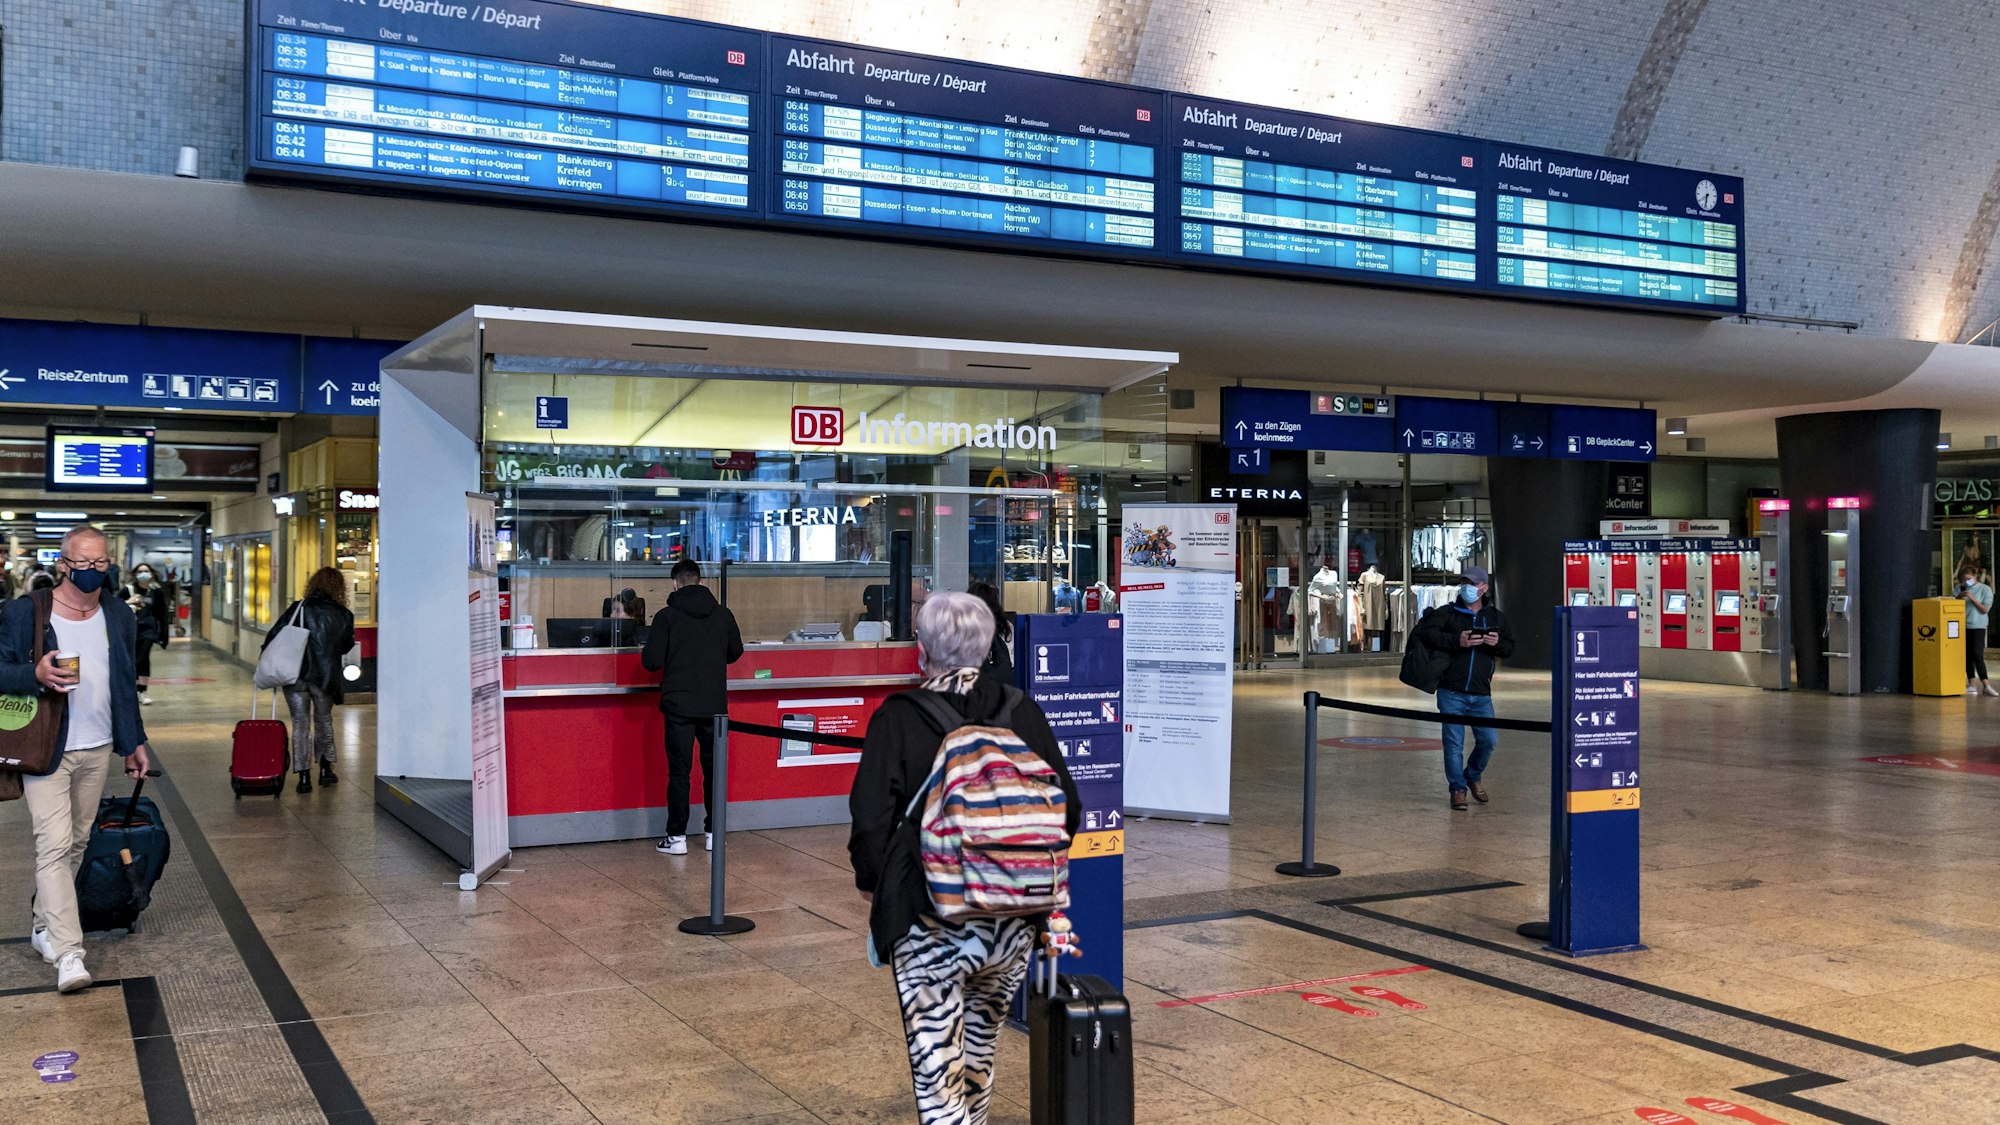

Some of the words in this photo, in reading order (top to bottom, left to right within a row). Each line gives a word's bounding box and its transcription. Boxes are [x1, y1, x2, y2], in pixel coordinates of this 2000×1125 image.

[483, 6, 541, 30] Départ
[275, 15, 297, 26] Zeit
[300, 19, 345, 34] Time/Temps
[379, 27, 402, 41] Über
[277, 46, 307, 58] 06:36
[277, 58, 307, 70] 06:37
[559, 54, 576, 65] Ziel
[580, 58, 616, 71] Destination
[728, 52, 745, 65] DB
[653, 66, 675, 79] Gleis
[678, 71, 720, 85] Platform/Voie
[786, 48, 855, 75] Abfahrt
[865, 63, 931, 86] Departure
[942, 74, 987, 95] Départ
[277, 78, 307, 90] 06:37
[559, 81, 618, 98] Bonn-Mehlem
[277, 90, 307, 102] 06:38
[558, 92, 586, 105] Essen
[786, 85, 801, 96] Zeit
[804, 88, 838, 100] Time/Temps
[786, 101, 809, 112] 06:44
[865, 94, 882, 106] Über
[886, 99, 896, 108] Via
[786, 111, 809, 122] 06:45
[1137, 109, 1150, 120] DB
[786, 122, 809, 133] 06:45
[1005, 115, 1018, 124] Ziel
[1021, 118, 1049, 128] Destination
[1183, 106, 1238, 129] Abfahrt
[1244, 118, 1298, 138] Departure
[1307, 127, 1342, 144] Départ
[276, 122, 305, 134] 06:41
[558, 123, 594, 136] Koblenz
[1079, 125, 1096, 135] Gleis
[276, 134, 305, 147] 06:42
[865, 133, 891, 143] Aachen
[1183, 138, 1195, 149] Zeit
[786, 140, 809, 150] 06:46
[1005, 140, 1025, 149] Berlin
[276, 146, 305, 159] 06:44
[378, 148, 421, 162] Dormagen
[428, 154, 455, 164] Neuss
[786, 151, 809, 161] 06:47
[1005, 150, 1023, 159] Paris
[1025, 151, 1042, 161] Nord
[1245, 146, 1260, 156] Über
[557, 153, 613, 171] Blankenberg
[1356, 162, 1367, 171] Ziel
[1462, 157, 1473, 167] DB
[429, 164, 471, 177] Longerich
[557, 165, 592, 178] Krefeld
[661, 166, 673, 176] 10
[1005, 165, 1019, 175] Kall
[1498, 152, 1542, 174] Abfahrt
[1548, 161, 1593, 181] Departure
[1600, 168, 1630, 186] Départ
[1415, 171, 1429, 180] Gleis
[557, 177, 603, 191] Worringen
[785, 179, 808, 190] 06:48
[1005, 176, 1035, 189] Bergisch
[1037, 179, 1069, 191] Gladbach
[1498, 182, 1509, 192] Zeit
[785, 190, 808, 201] 06:49
[1548, 187, 1561, 198] Über
[785, 201, 808, 212] 06:50
[907, 203, 927, 212] Essen
[961, 209, 993, 219] Dortmund
[1005, 203, 1031, 213] Aachen
[1005, 213, 1027, 222] Hamm
[1028, 215, 1041, 224] (W)
[1005, 223, 1030, 233] Horrem
[38, 367, 129, 384] ReiseZentrum
[351, 382, 365, 391] zu
[1334, 397, 1345, 412] S
[796, 410, 840, 442] DB
[859, 411, 1058, 451] Information
[1265, 421, 1278, 430] den
[1279, 421, 1301, 432] Zügen
[1254, 432, 1294, 442] koelnmesse
[1586, 437, 1595, 446] DB
[1596, 437, 1636, 447] GepäckCenter
[1253, 448, 1261, 465] 1
[1210, 487, 1303, 499] ETERNA
[1935, 479, 1993, 503] GLAS
[763, 505, 858, 528] ETERNA
[1216, 513, 1229, 523] DB
[1109, 620, 1119, 628] DB
[1049, 693, 1063, 701] kein
[1064, 690, 1120, 701] Fahrkartenverkauf
